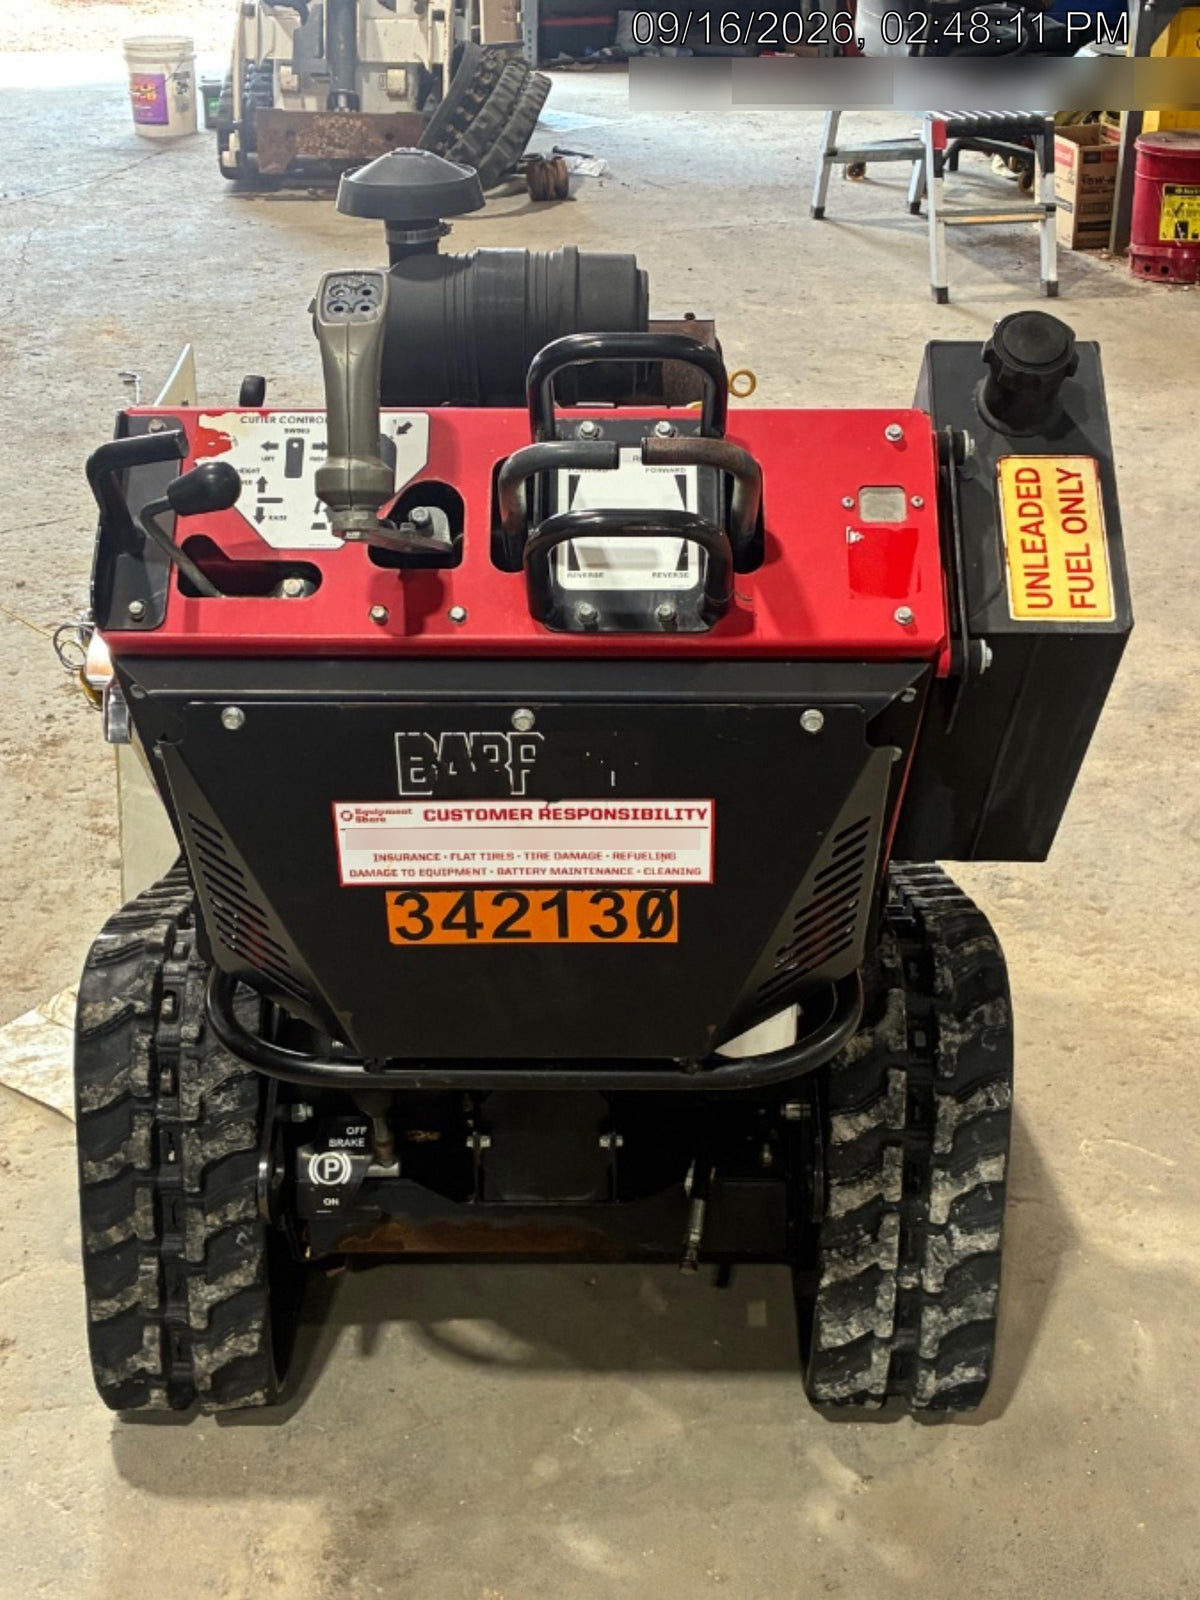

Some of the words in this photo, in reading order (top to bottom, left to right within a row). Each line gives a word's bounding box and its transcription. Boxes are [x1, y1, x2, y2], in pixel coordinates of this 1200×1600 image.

[240, 415, 277, 424] CUTTER
[1056, 467, 1088, 534] ONLY
[1014, 467, 1054, 609] UNLEADED
[1064, 542, 1097, 609] FUEL
[354, 807, 413, 817] Equipment
[422, 807, 533, 822] CUSTOMER
[538, 807, 708, 821] RESPONSIBILITY
[354, 815, 387, 824] Share
[373, 852, 442, 863] INSURANCE
[450, 852, 477, 862] FLAT
[480, 852, 515, 861] TIRES
[525, 851, 551, 861] TIRE
[553, 851, 603, 861] DAMAGE
[612, 851, 677, 862] REFUELING
[349, 867, 399, 878] DAMAGE
[401, 868, 416, 878] TO
[418, 867, 487, 878] EQUIPMENT
[496, 867, 547, 877] BATTERY
[549, 866, 634, 877] MAINTENANCE
[643, 866, 702, 876] CLEANING
[393, 889, 675, 941] 342130
[346, 1126, 367, 1135] OFF
[328, 1138, 366, 1147] BRAKE
[323, 1197, 340, 1206] ON
